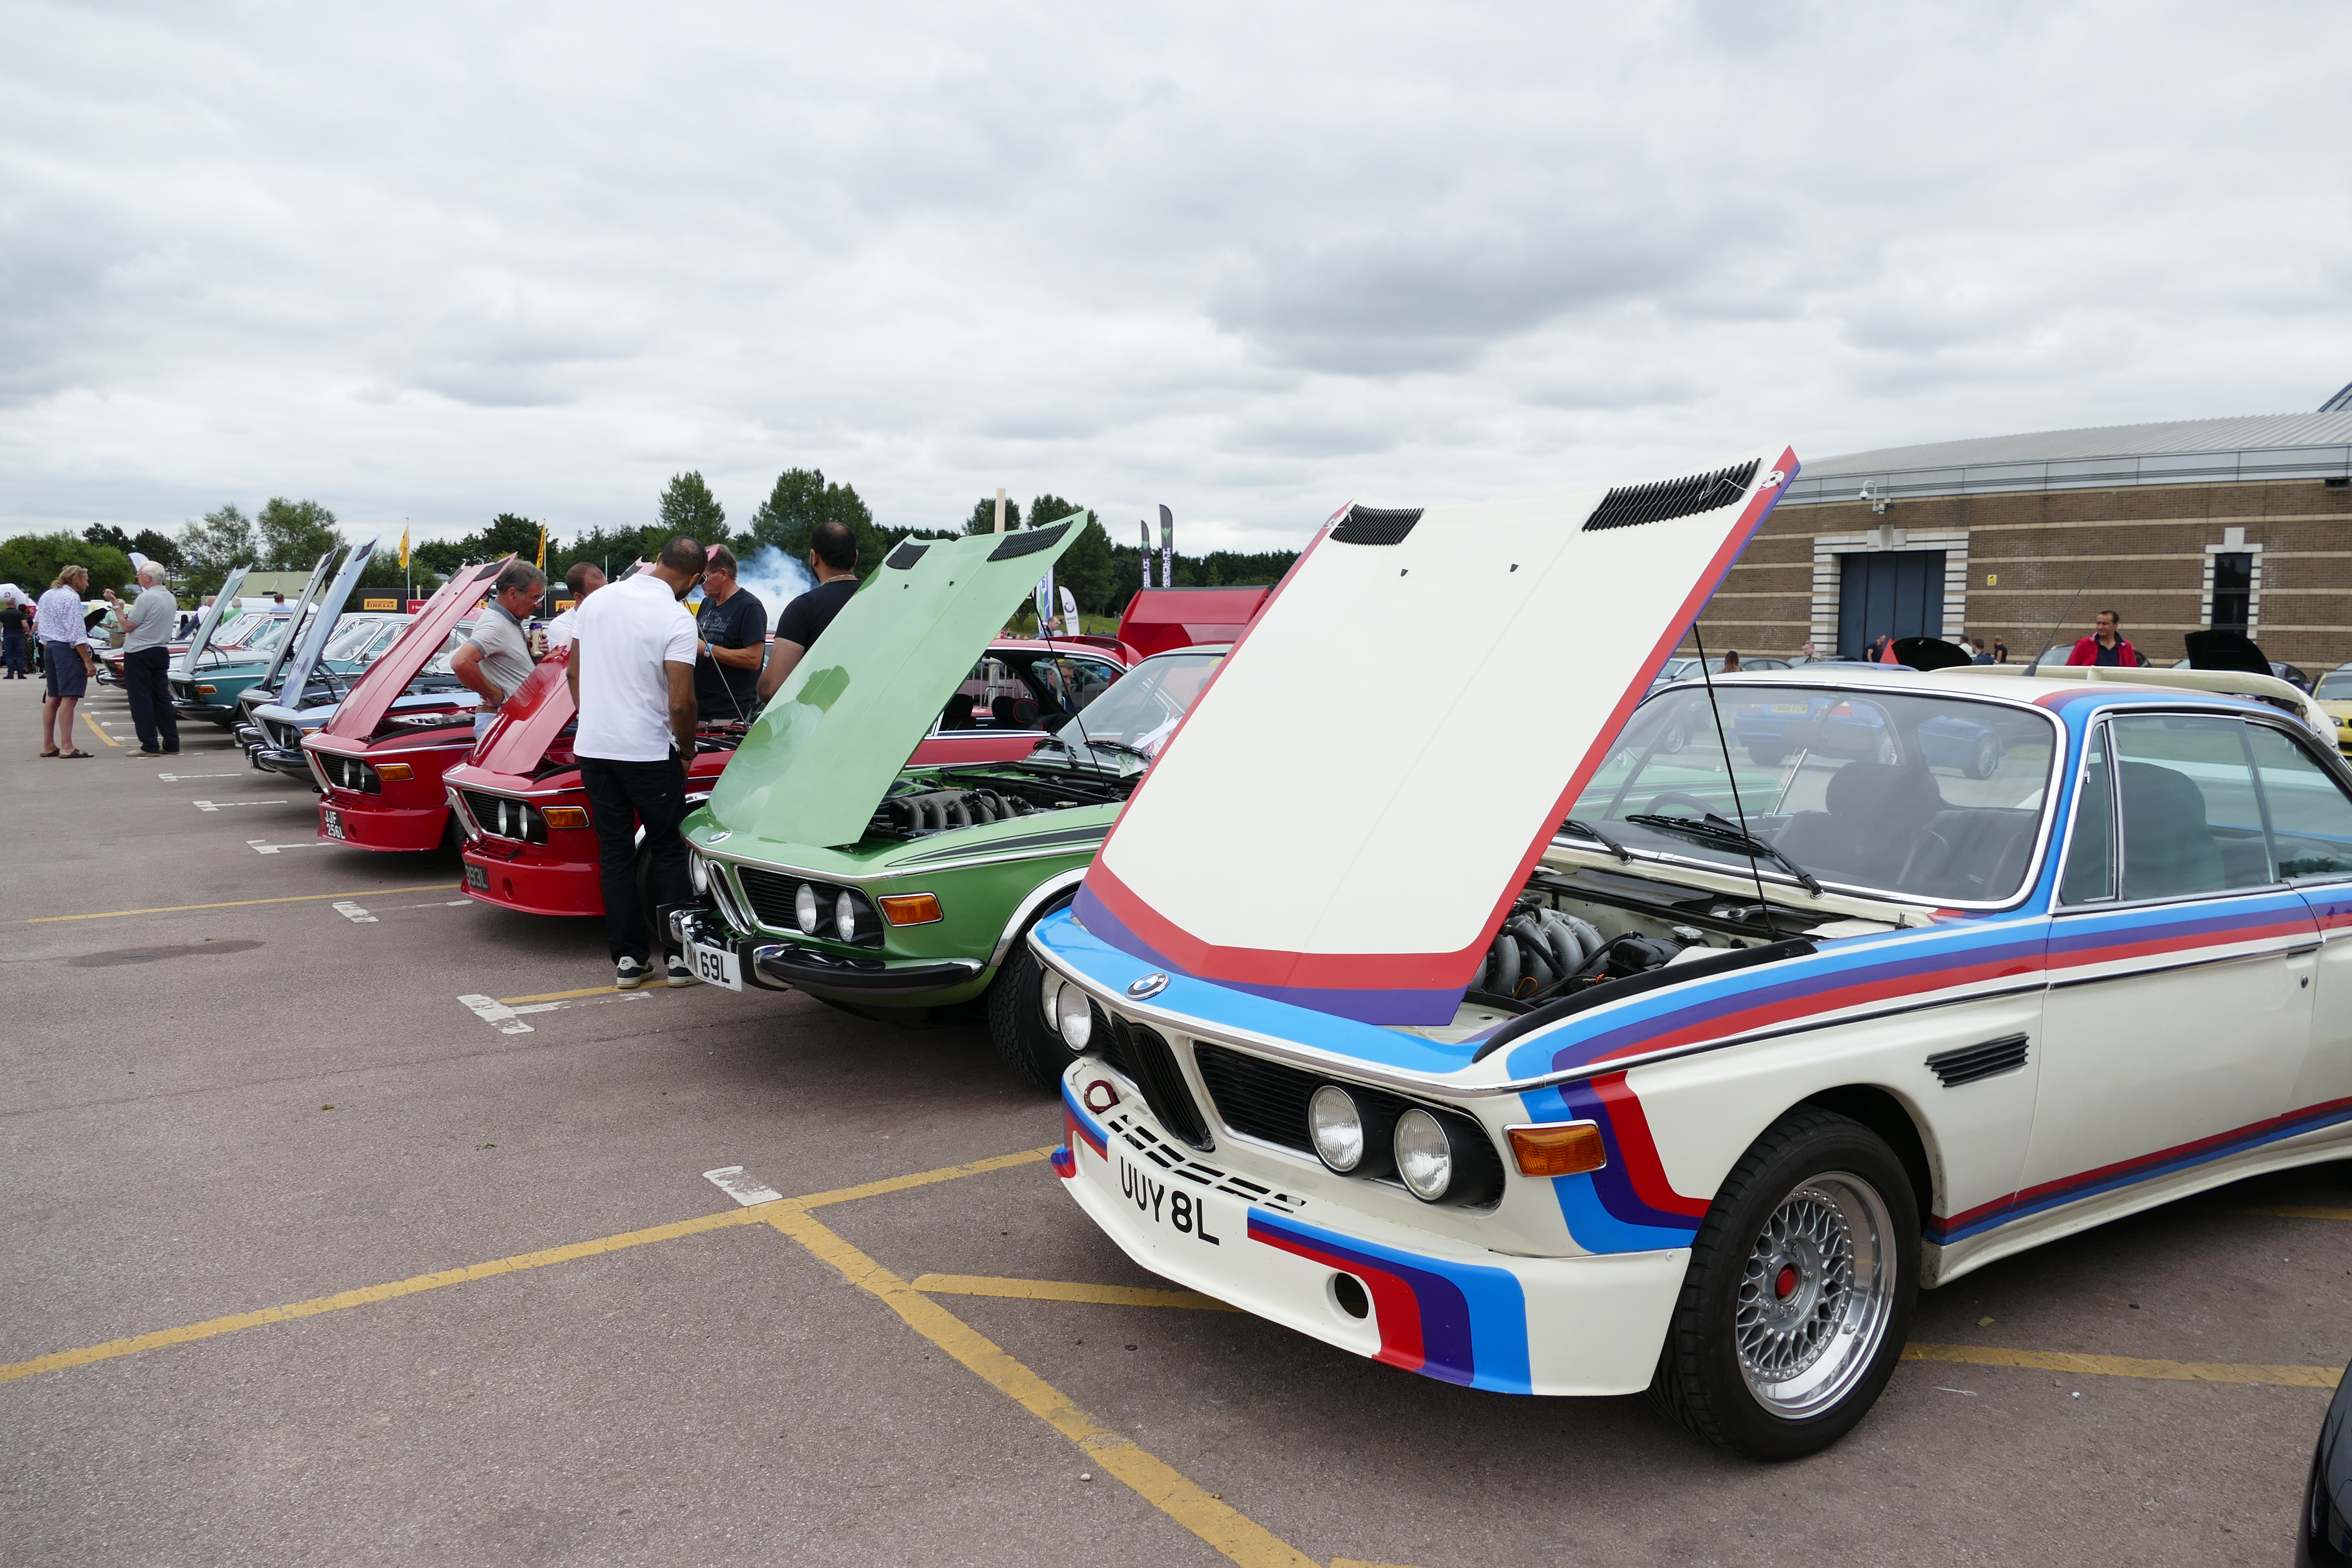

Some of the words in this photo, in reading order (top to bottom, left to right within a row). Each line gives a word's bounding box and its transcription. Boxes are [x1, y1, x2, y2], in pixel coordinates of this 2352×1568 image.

[325, 810, 337, 824] JJF
[327, 823, 346, 839] 256L
[700, 951, 730, 984] 69L
[1120, 1155, 1164, 1223] UUY
[1171, 1190, 1220, 1246] 8L
